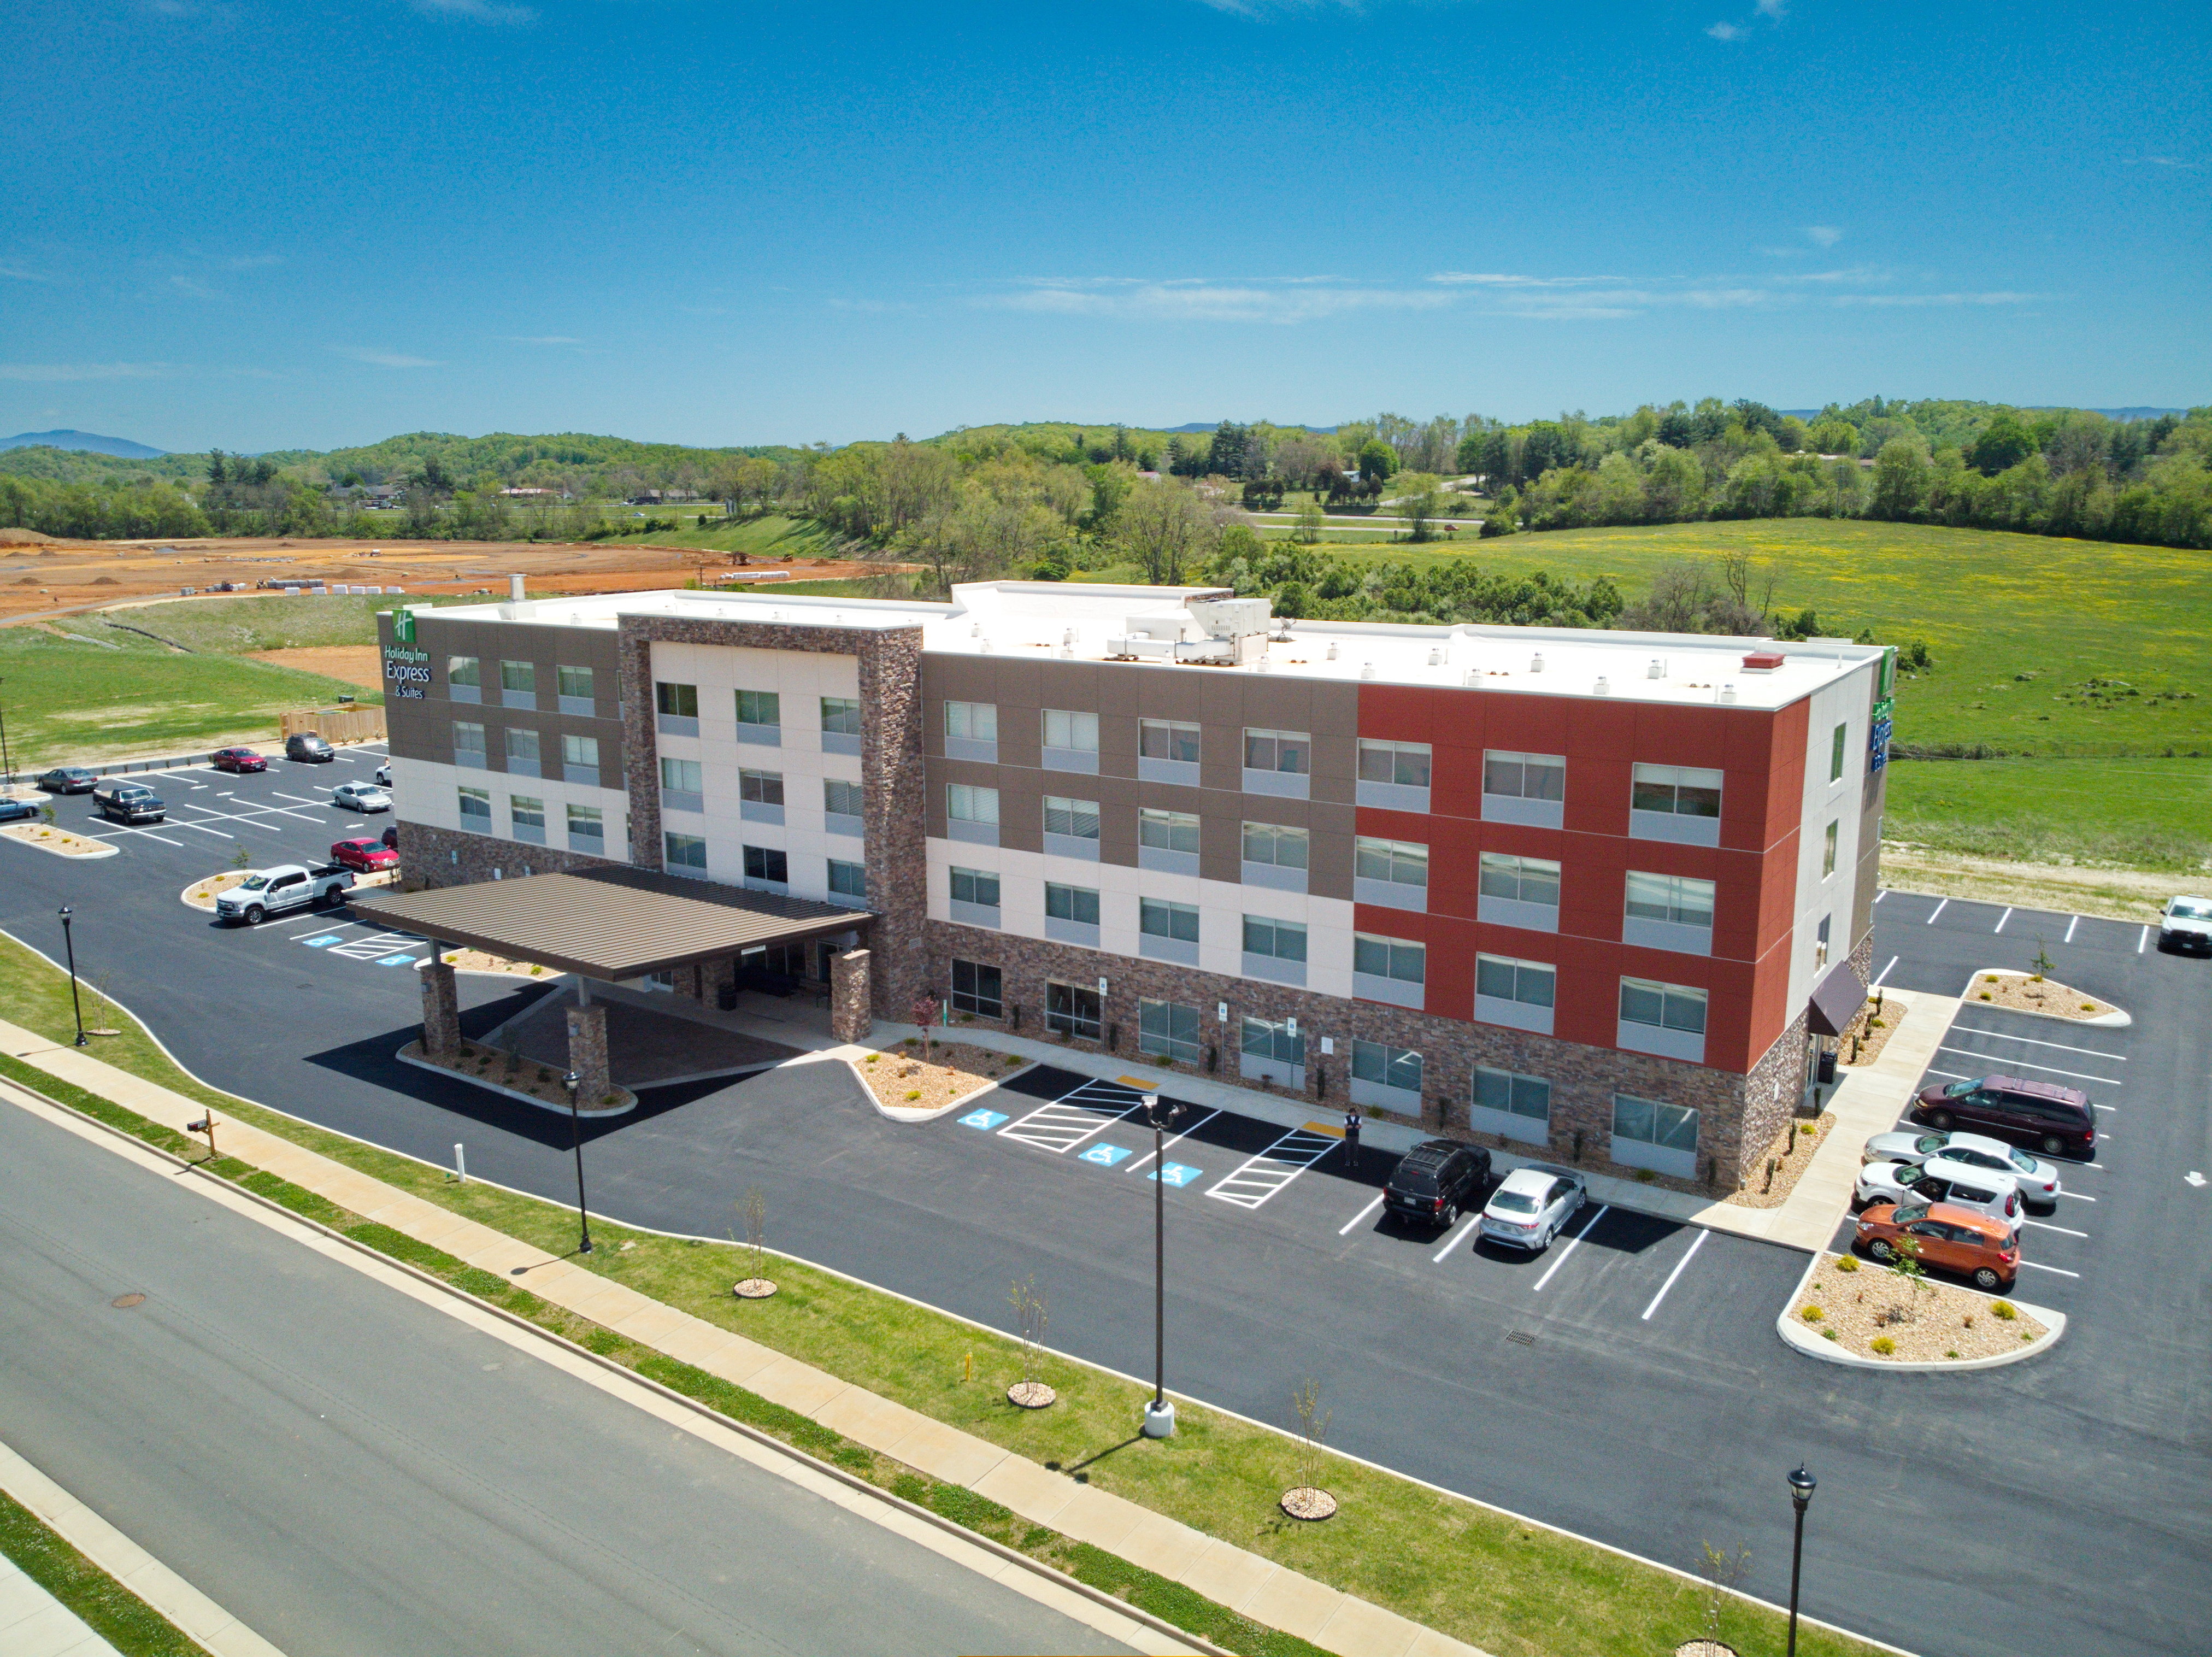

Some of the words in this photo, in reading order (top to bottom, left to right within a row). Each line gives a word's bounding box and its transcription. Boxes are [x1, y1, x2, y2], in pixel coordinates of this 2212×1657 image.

[385, 645, 414, 663] Holiday
[415, 648, 428, 661] Inn
[387, 661, 429, 684] Express
[396, 685, 401, 696] &
[402, 686, 423, 699] Suites
